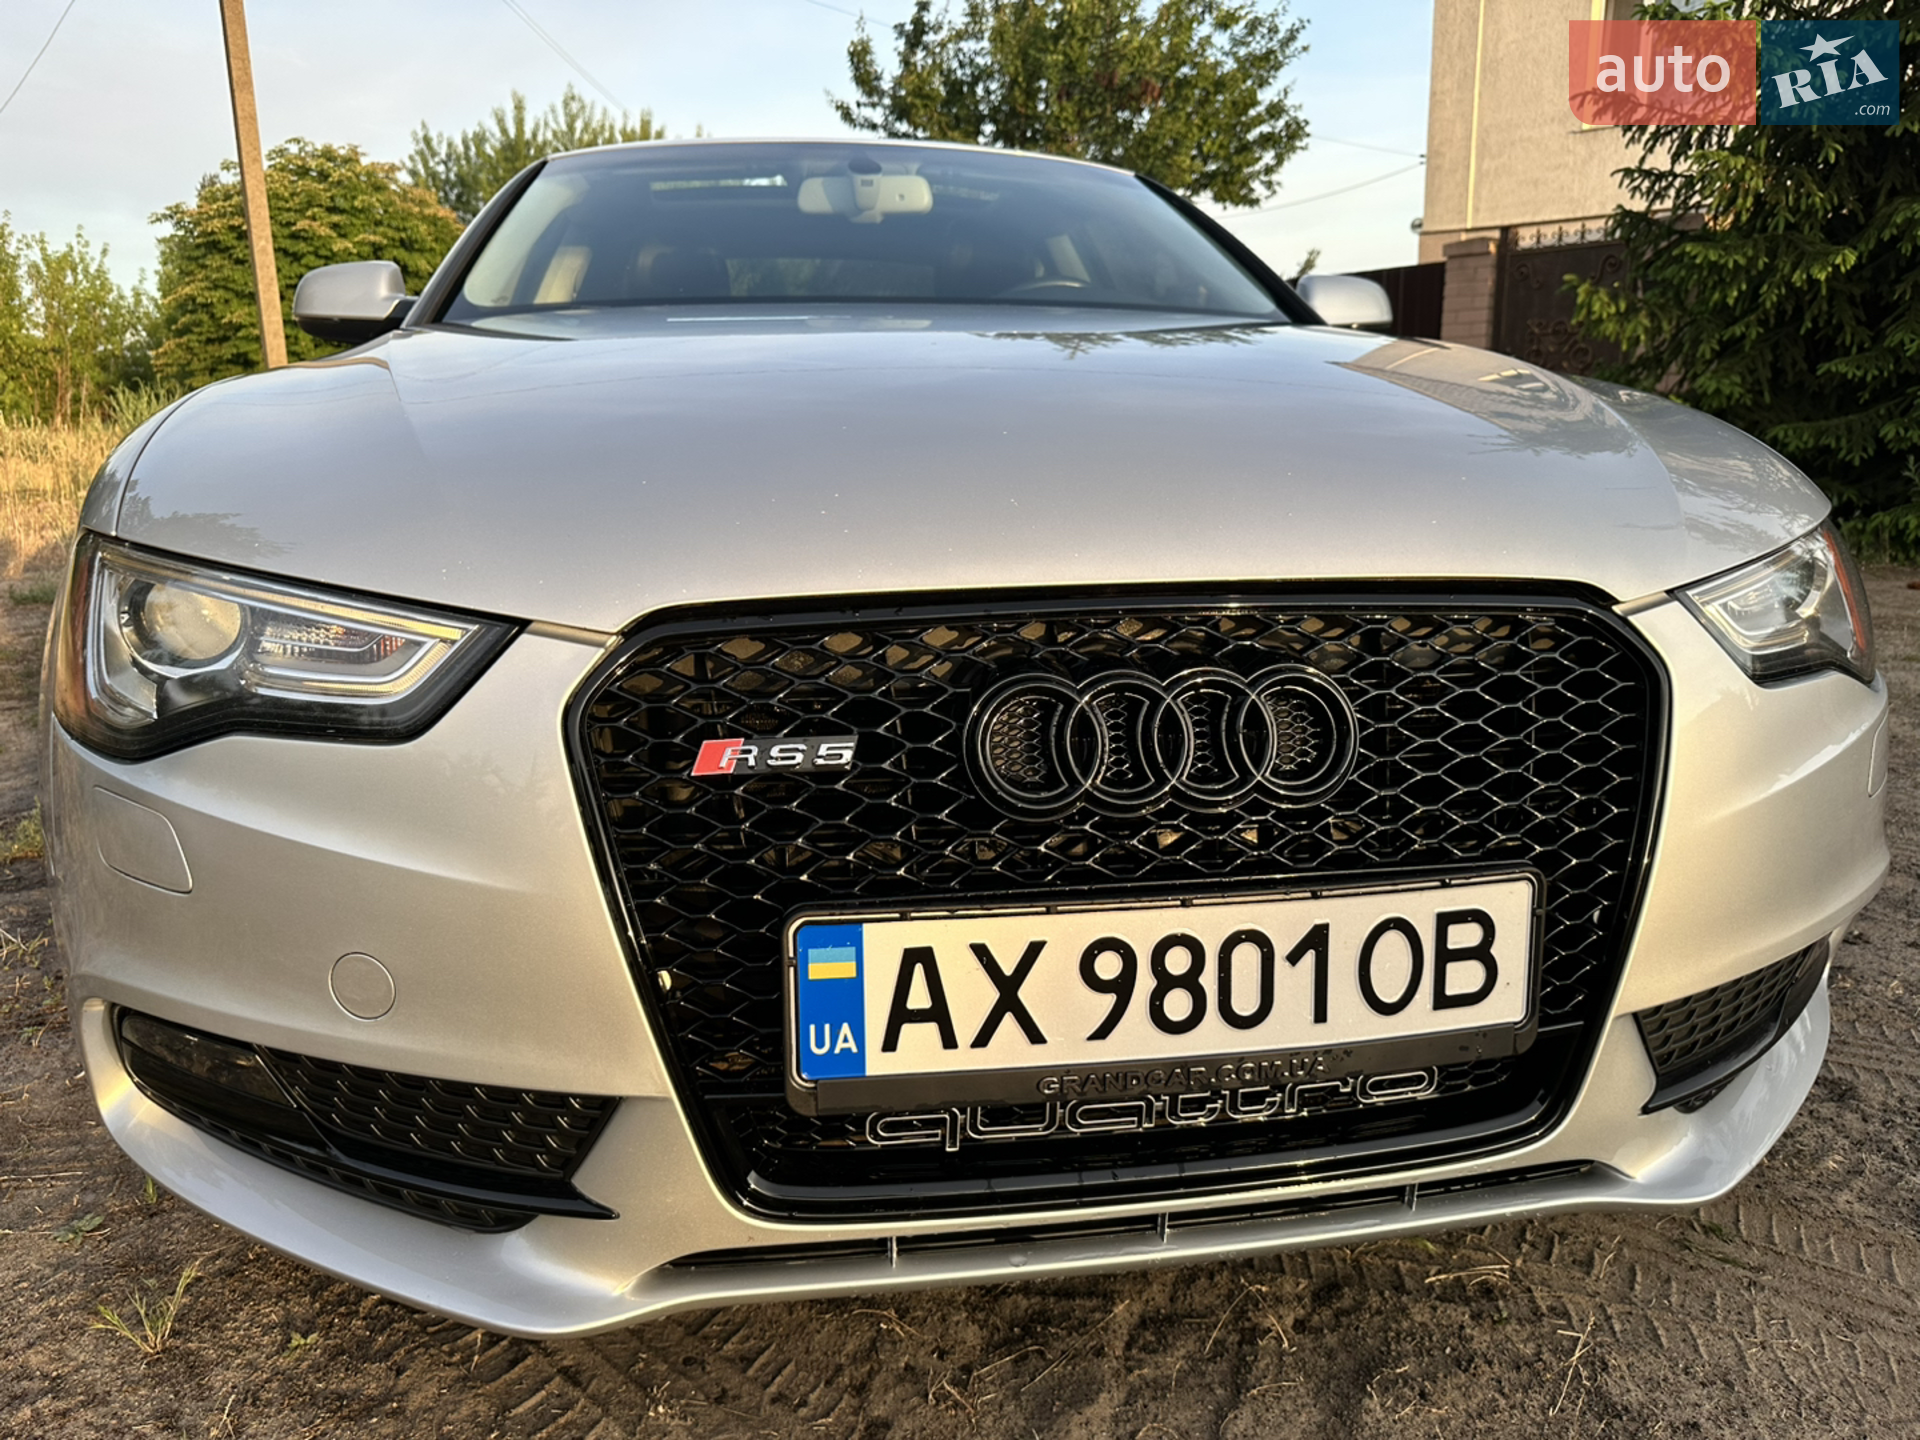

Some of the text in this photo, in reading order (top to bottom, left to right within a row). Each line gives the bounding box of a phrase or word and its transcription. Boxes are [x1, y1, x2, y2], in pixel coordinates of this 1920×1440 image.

[718, 743, 854, 769] RS5
[881, 907, 1499, 1053] AX 9801 OB
[809, 1022, 858, 1056] UA
[1037, 1055, 1330, 1095] GRANDCAR.COM.UA
[865, 1066, 1438, 1152] quattro
